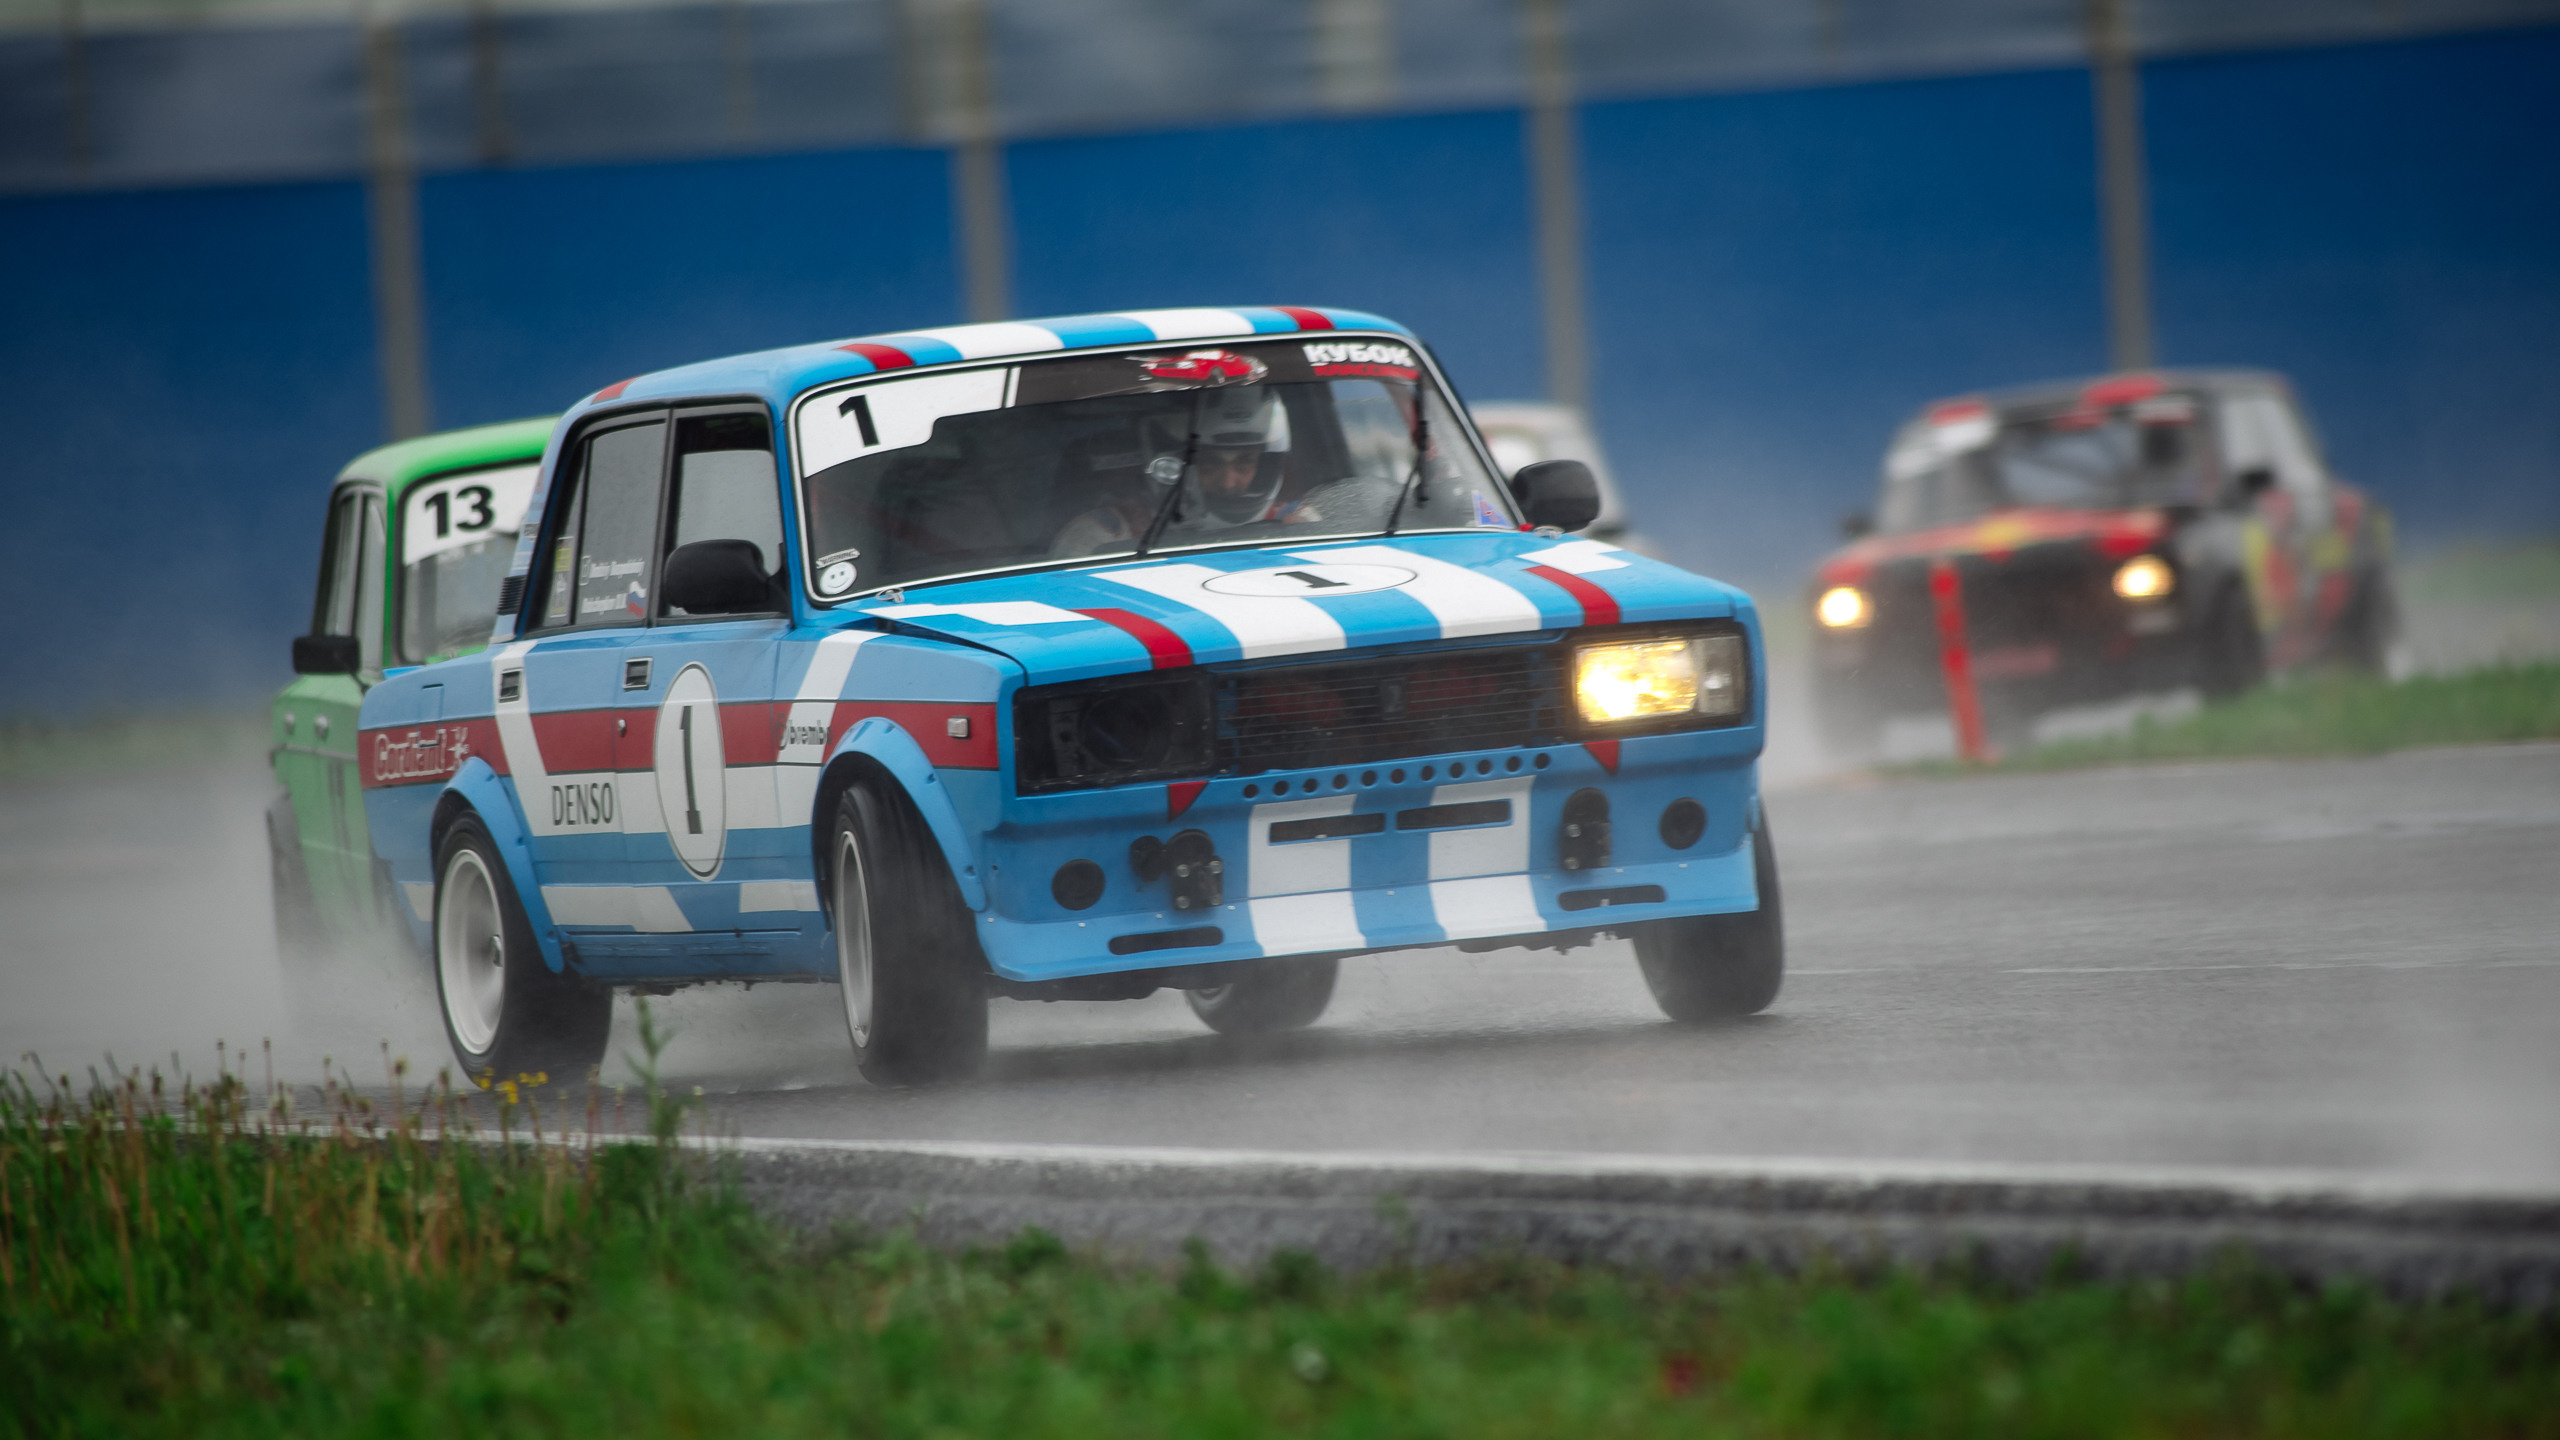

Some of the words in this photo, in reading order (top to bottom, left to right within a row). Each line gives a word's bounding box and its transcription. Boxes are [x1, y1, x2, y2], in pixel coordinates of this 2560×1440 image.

[1302, 343, 1416, 368] КУБОК
[838, 394, 880, 447] 1
[424, 485, 495, 538] 13
[1274, 571, 1350, 589] 1
[680, 706, 702, 834] 1
[552, 783, 614, 826] DENSO
